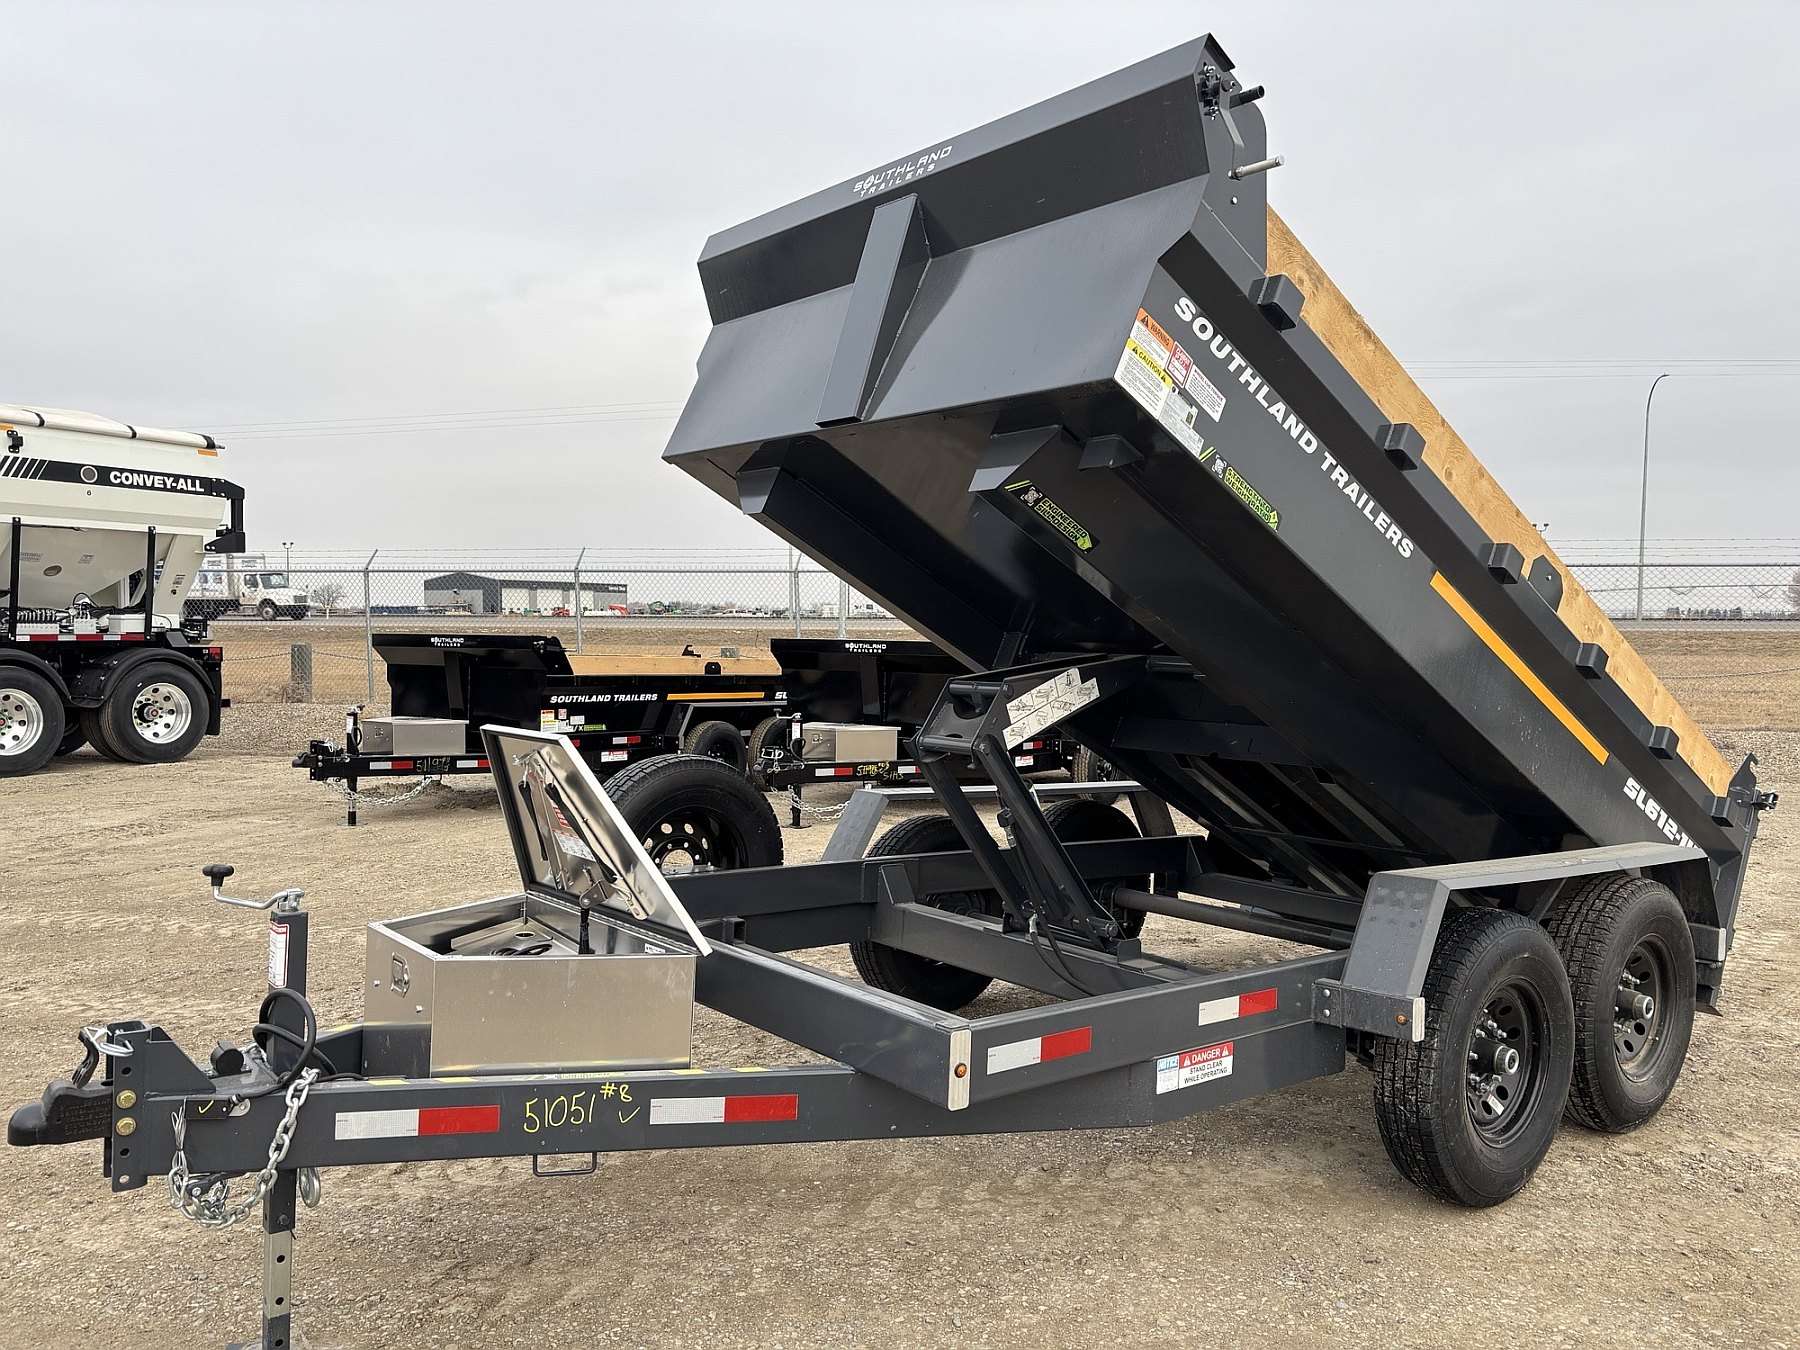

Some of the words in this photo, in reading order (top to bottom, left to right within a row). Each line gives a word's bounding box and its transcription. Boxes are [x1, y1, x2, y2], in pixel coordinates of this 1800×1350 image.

[853, 146, 952, 193] SOUTHLAND
[860, 163, 936, 198] TRAILERS
[1138, 348, 1162, 379] CAUTION
[1174, 297, 1318, 453] SOUTHLAND
[1320, 451, 1414, 558] TRAILERS
[109, 470, 205, 492] CONVEY-ALL
[1041, 499, 1088, 538] ENGINEERED
[1052, 518, 1080, 541] DESIGN
[550, 694, 611, 704] SOUTHLAND
[613, 693, 658, 702] TRAILERS
[1189, 1064, 1206, 1075] STAND
[1206, 1060, 1223, 1070] CLEAR
[1191, 1048, 1221, 1064] DANGER
[1183, 1075, 1200, 1084] WHILE
[1200, 1067, 1228, 1080] OPERATING
[523, 1091, 596, 1133] 51051
[600, 1082, 633, 1102] #8
